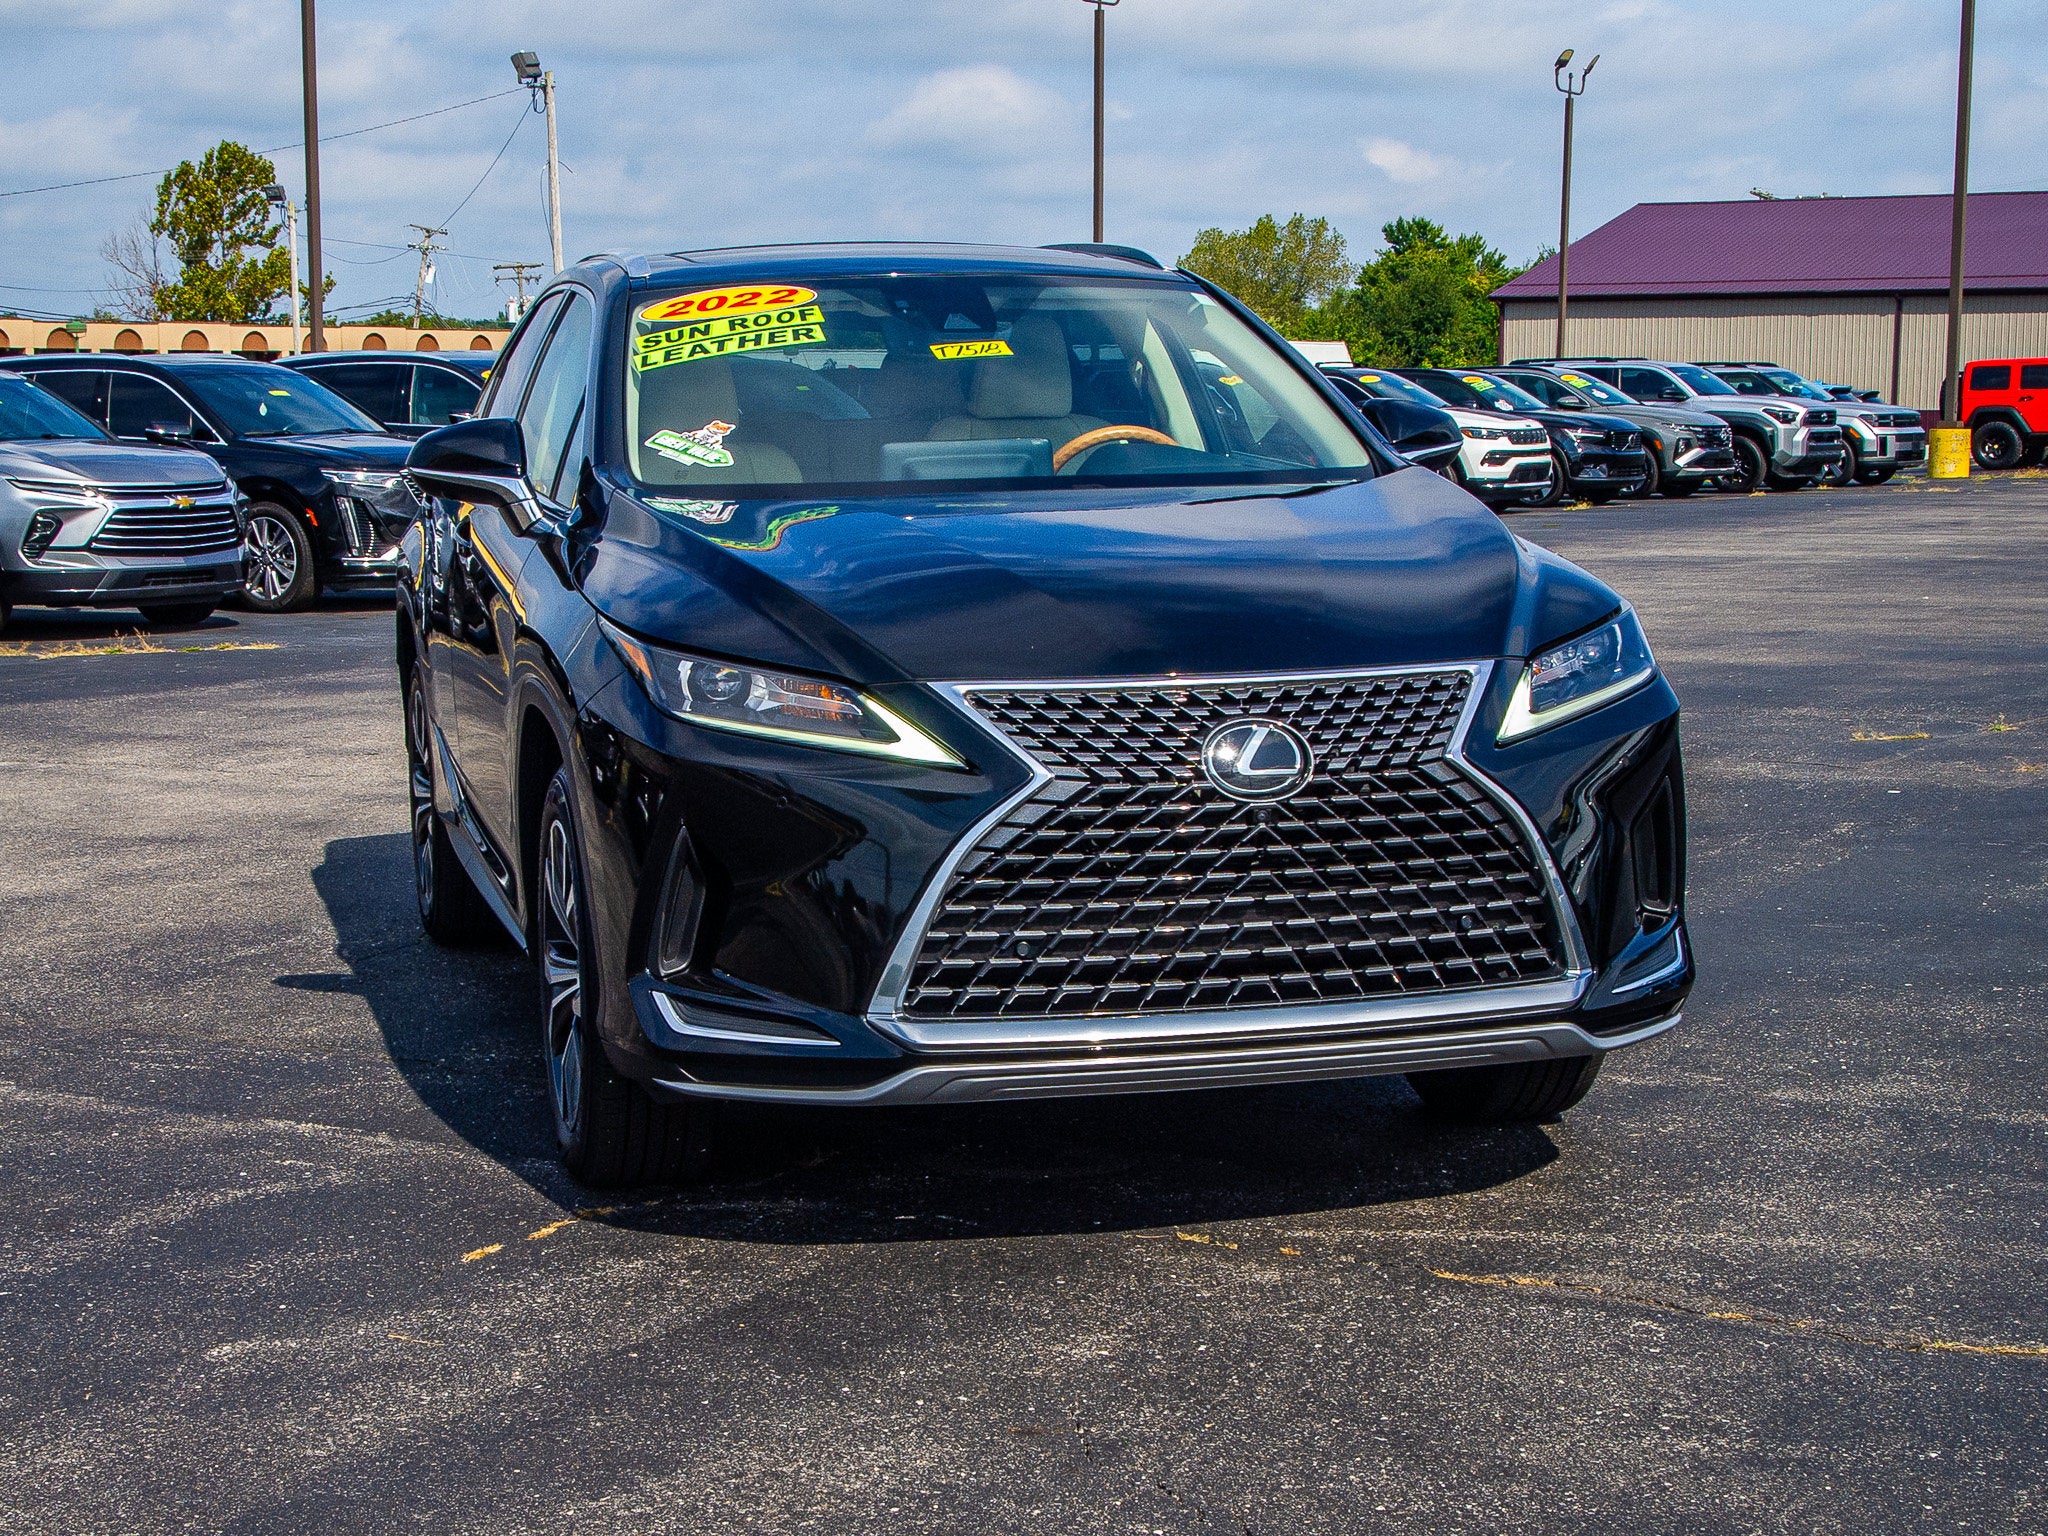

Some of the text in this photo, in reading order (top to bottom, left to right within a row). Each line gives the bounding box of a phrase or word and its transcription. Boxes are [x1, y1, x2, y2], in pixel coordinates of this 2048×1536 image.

[659, 288, 799, 319] 2022
[642, 308, 815, 349] SUN ROOF
[640, 326, 816, 369] LEATHER
[934, 342, 1002, 358] T7518
